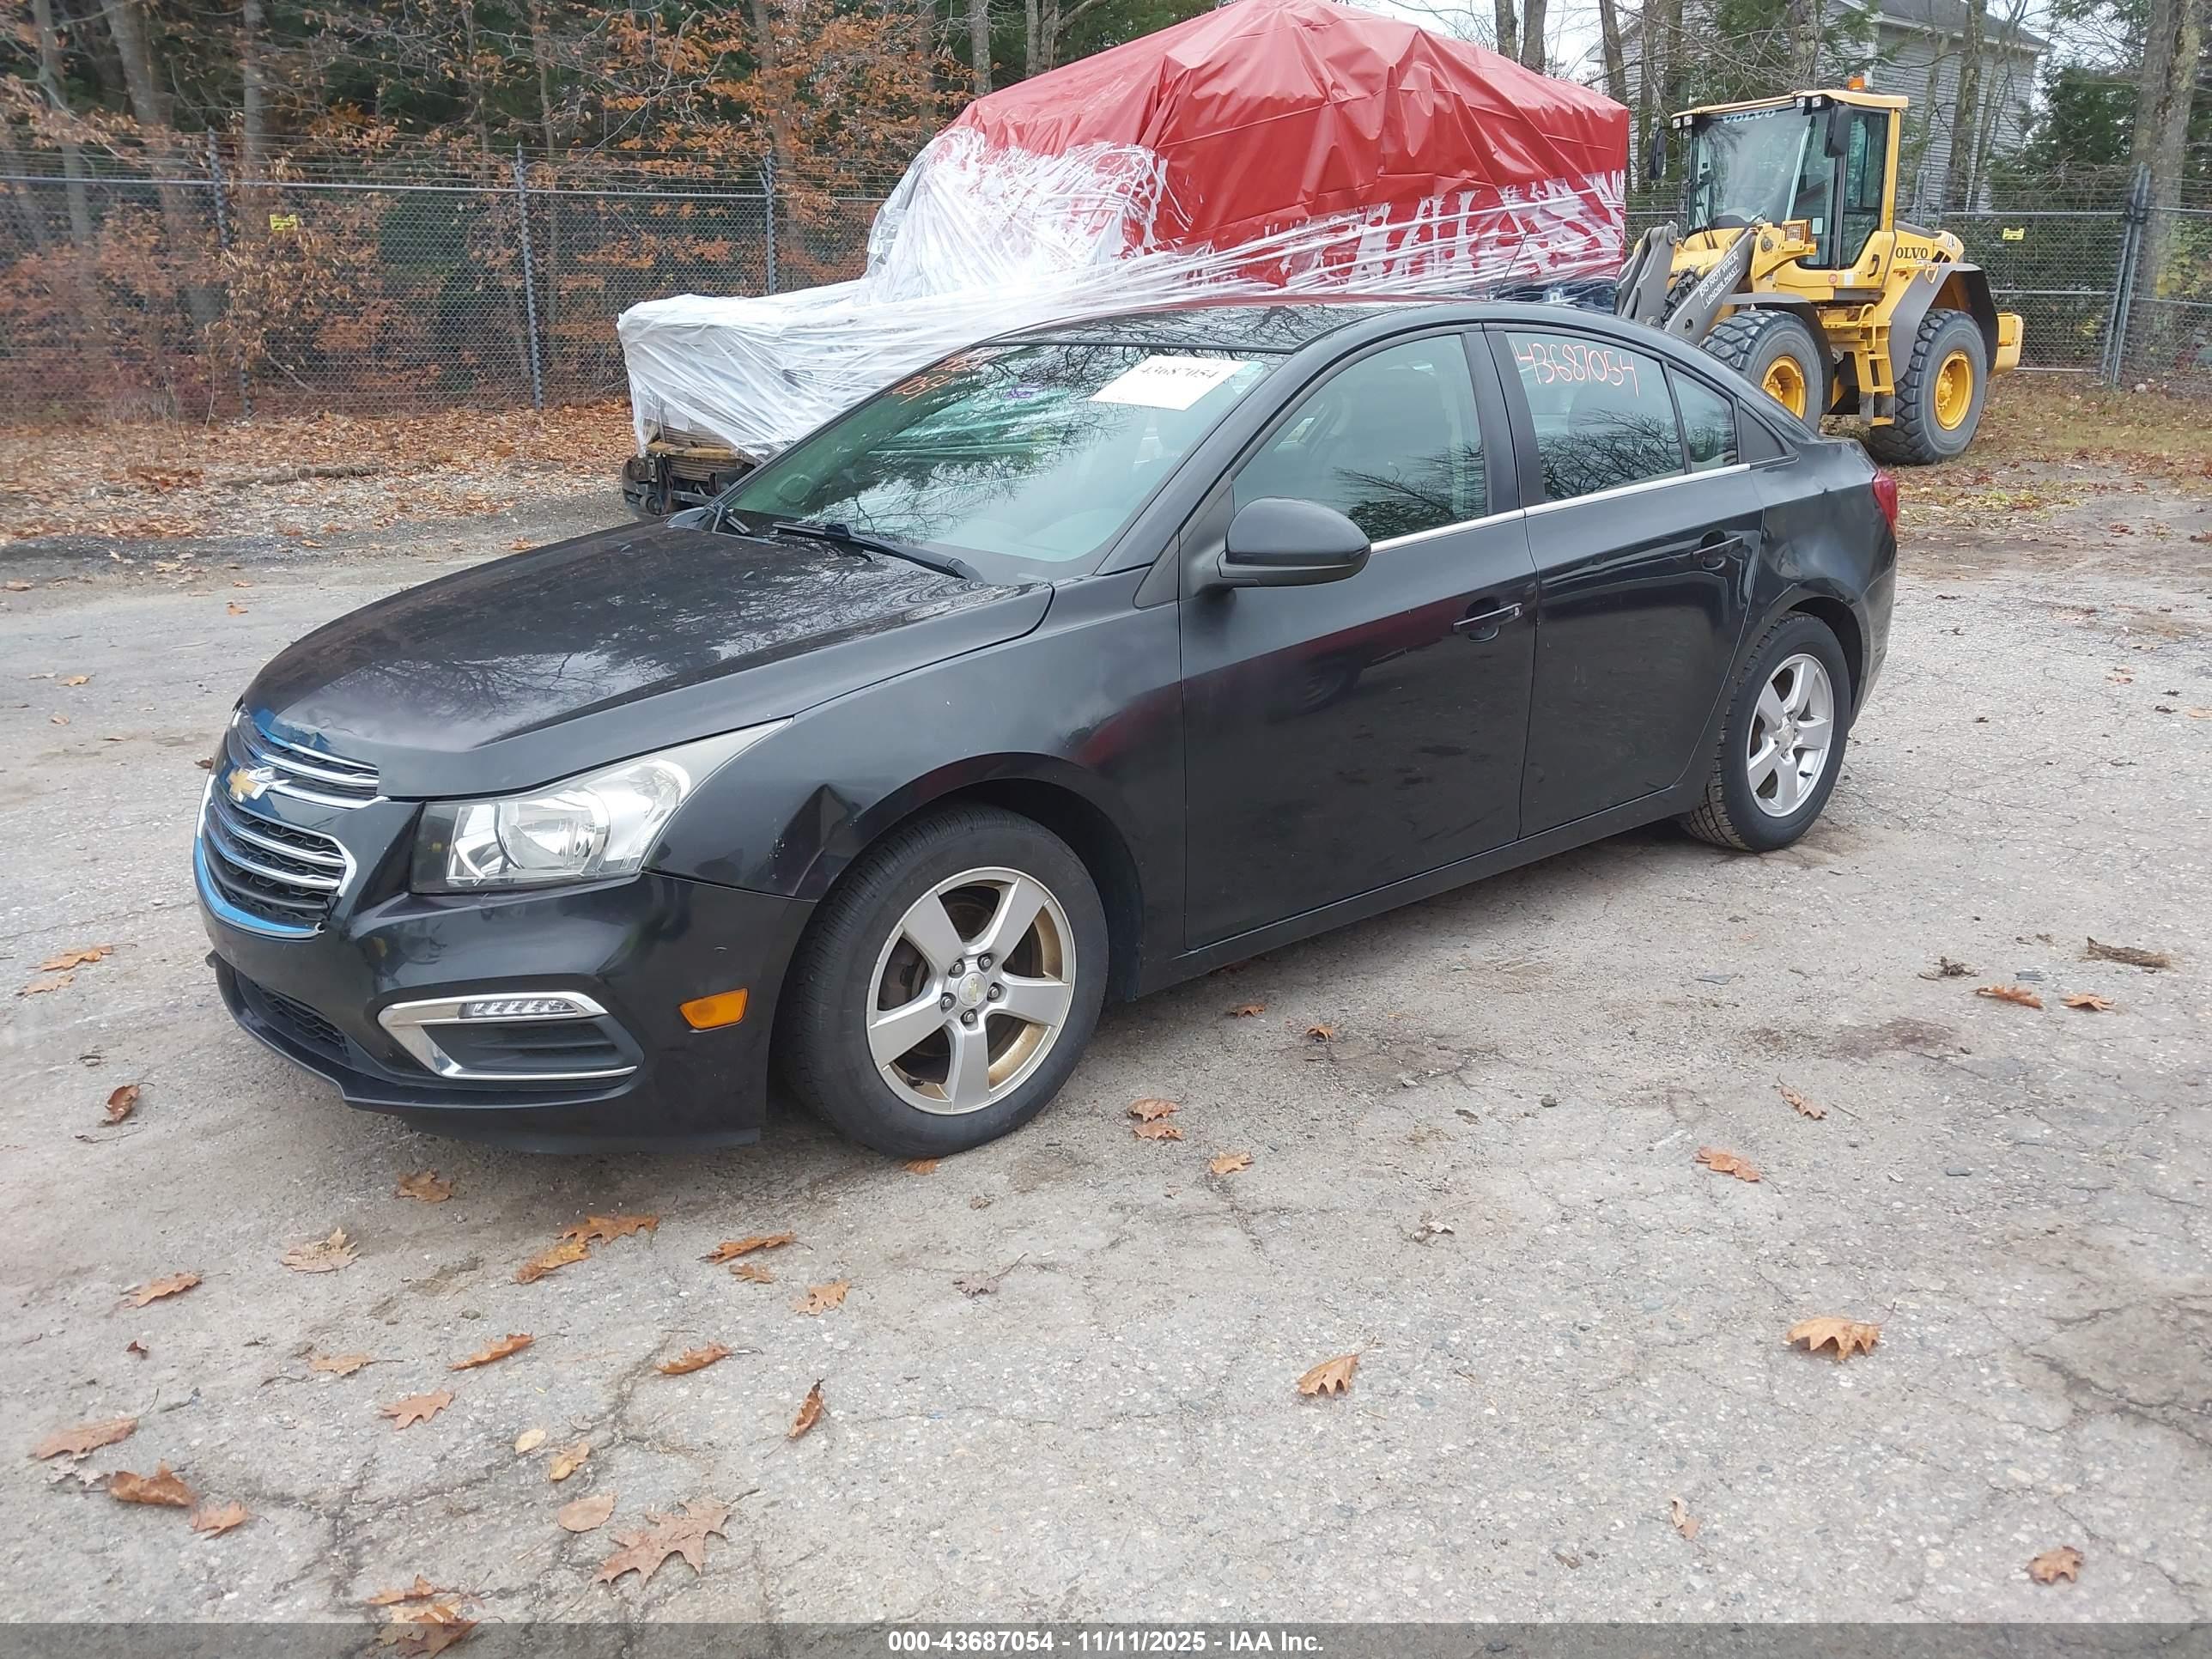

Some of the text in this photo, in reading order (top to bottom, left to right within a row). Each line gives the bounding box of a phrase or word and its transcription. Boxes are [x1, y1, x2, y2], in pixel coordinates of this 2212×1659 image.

[1721, 109, 1777, 125] VOLVO
[1895, 246, 1929, 259] OLVO
[1698, 252, 1739, 297] DO NOT WALK
[1705, 282, 1725, 305] UNDER
[1511, 340, 1640, 398] 43687054
